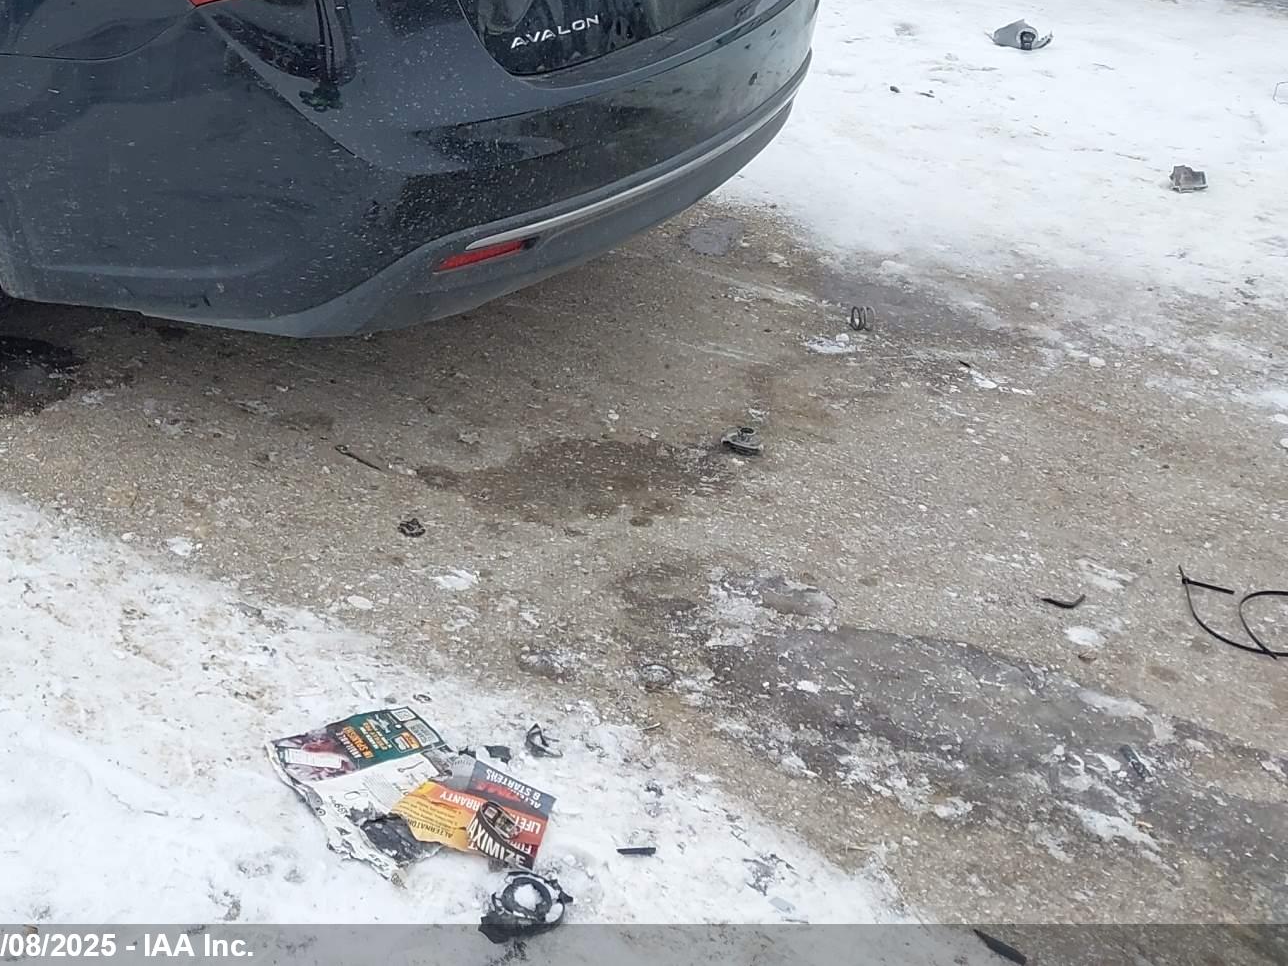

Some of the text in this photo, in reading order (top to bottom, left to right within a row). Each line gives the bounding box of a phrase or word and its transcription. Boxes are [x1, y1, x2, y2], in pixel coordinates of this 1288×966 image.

[510, 15, 600, 50] AVALON
[485, 768, 532, 796] STARTERS
[532, 792, 541, 801] &
